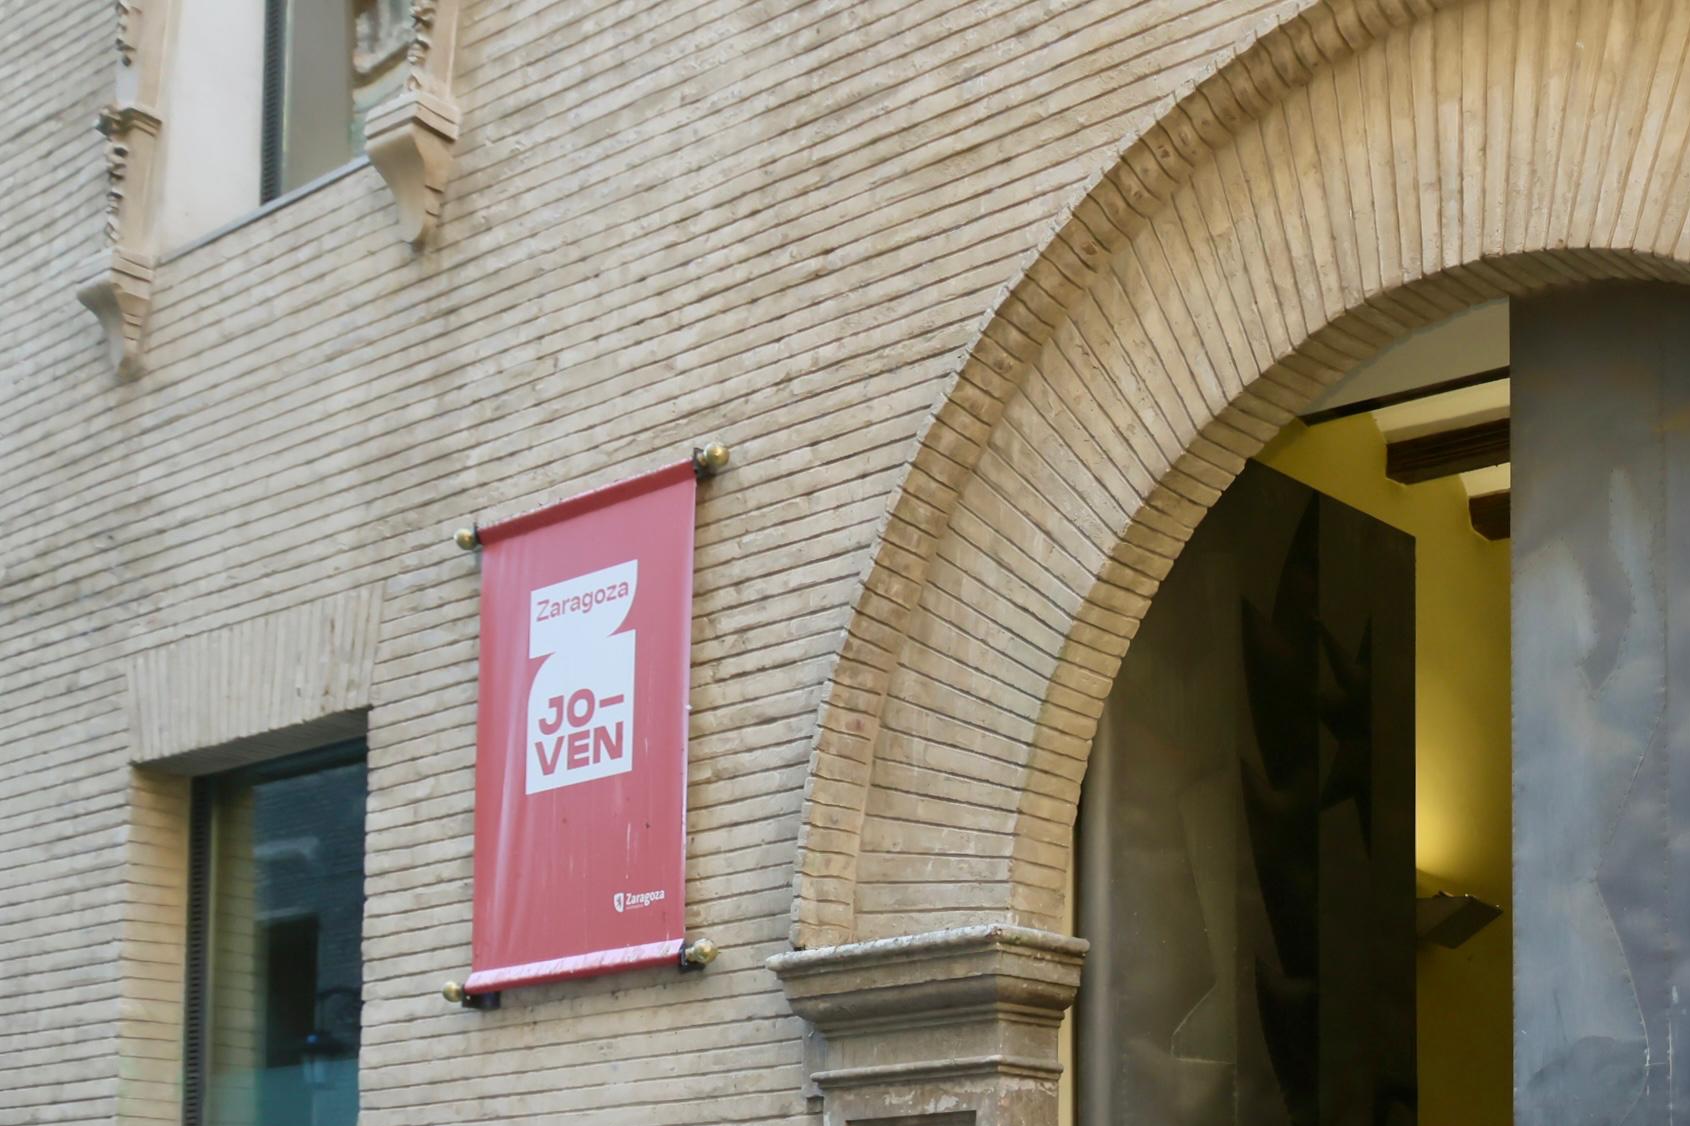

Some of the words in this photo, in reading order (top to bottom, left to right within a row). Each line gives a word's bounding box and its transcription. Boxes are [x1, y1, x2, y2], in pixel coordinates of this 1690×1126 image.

[536, 581, 629, 622] Zaragoza
[534, 721, 624, 776] VEN
[625, 889, 665, 907] Zaragoza
